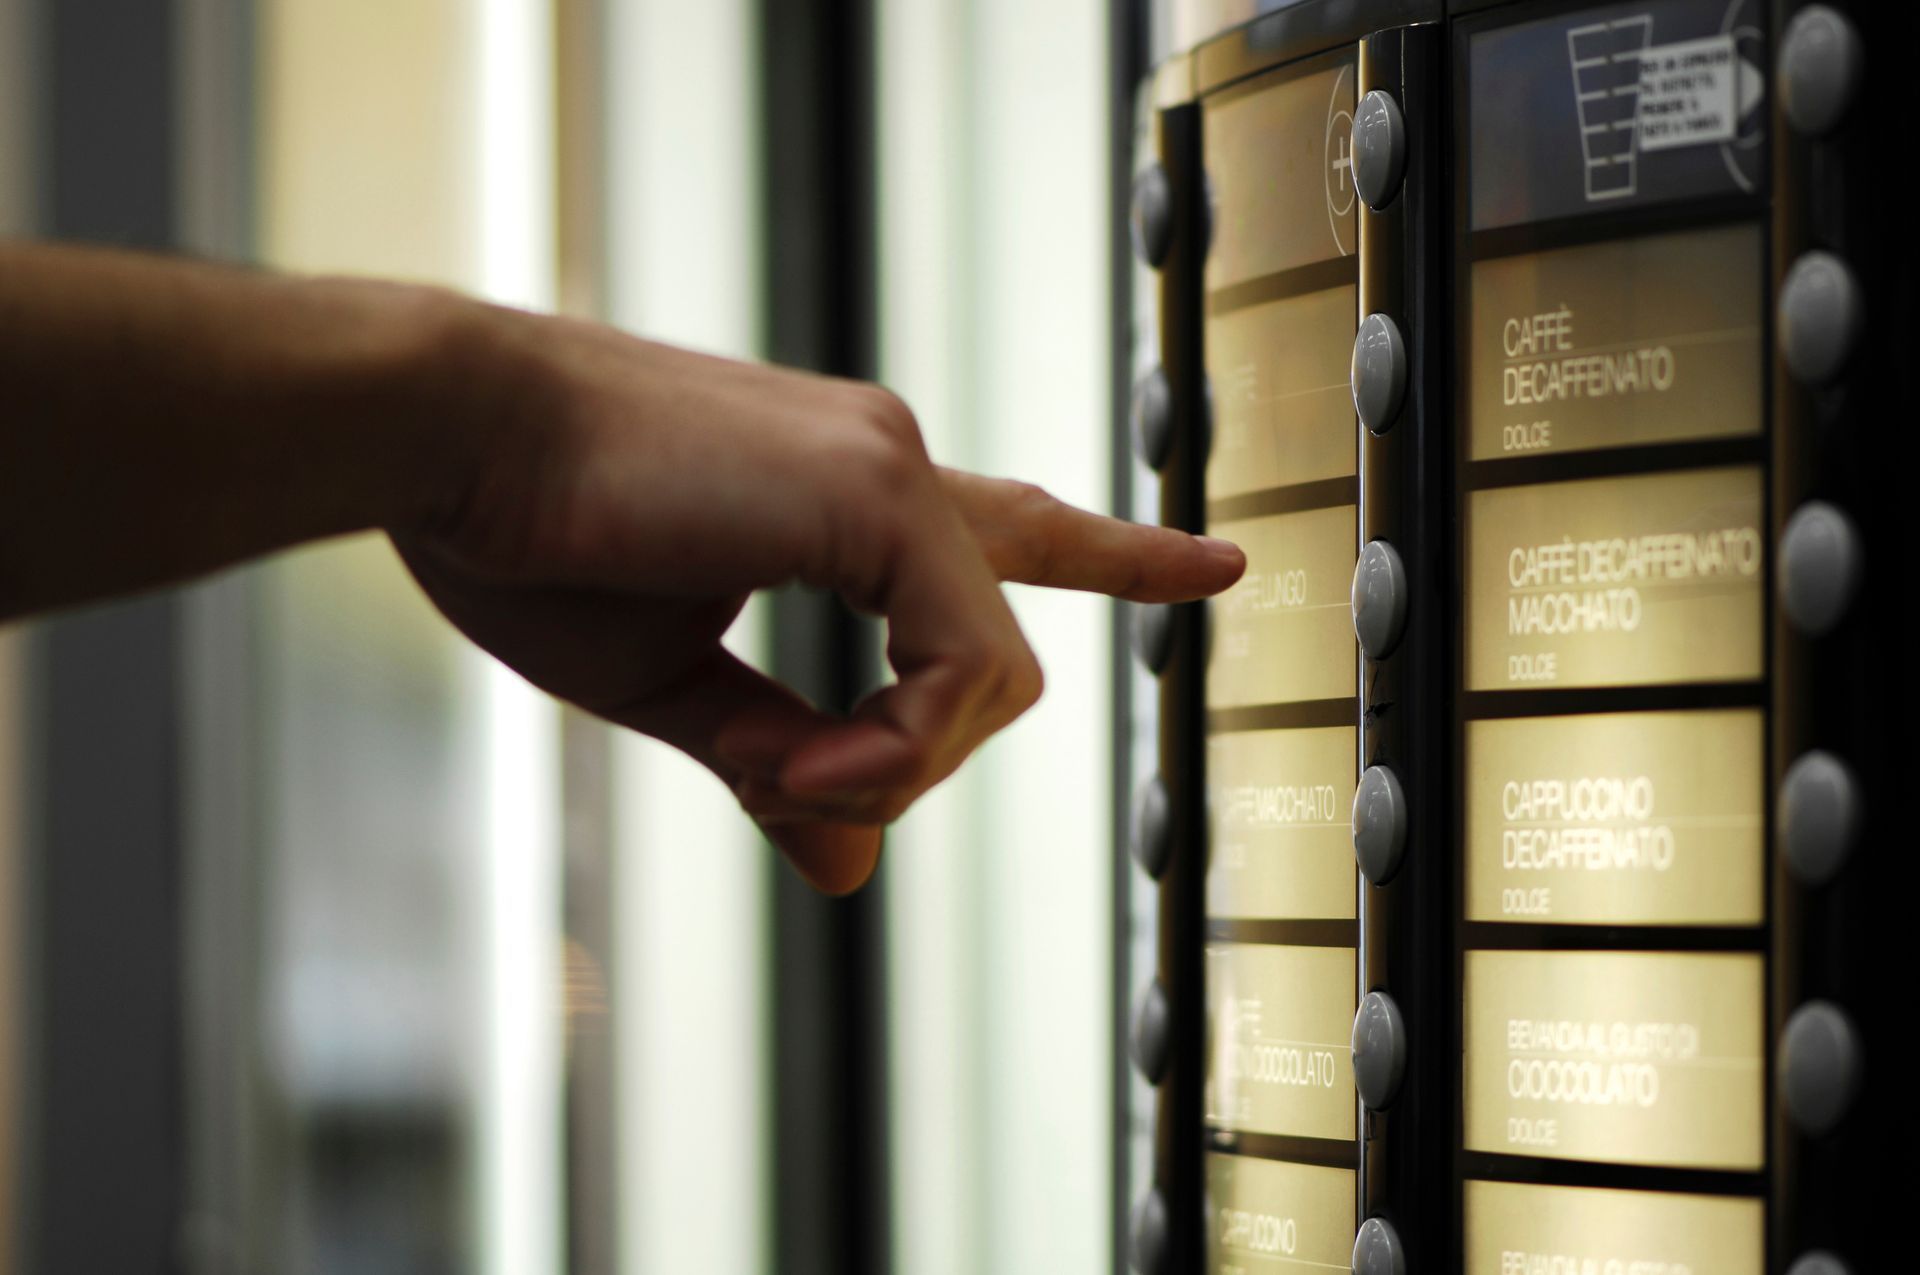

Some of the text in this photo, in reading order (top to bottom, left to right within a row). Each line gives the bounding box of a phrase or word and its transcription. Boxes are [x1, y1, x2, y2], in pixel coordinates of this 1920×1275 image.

[1503, 302, 1573, 357] CAFFÈ
[1503, 420, 1551, 451] DOLCE
[1508, 535, 1576, 587] CAFFÈ
[1508, 586, 1642, 636] MACCHIATO
[1508, 653, 1557, 681] DOLCE
[1256, 784, 1335, 822] MACCHIATO
[1502, 776, 1655, 821] CAPPUCCINO
[1502, 887, 1551, 915] DOLCE
[1508, 1059, 1659, 1107] CIOCCOLATO
[1508, 1117, 1557, 1146] DOLCE
